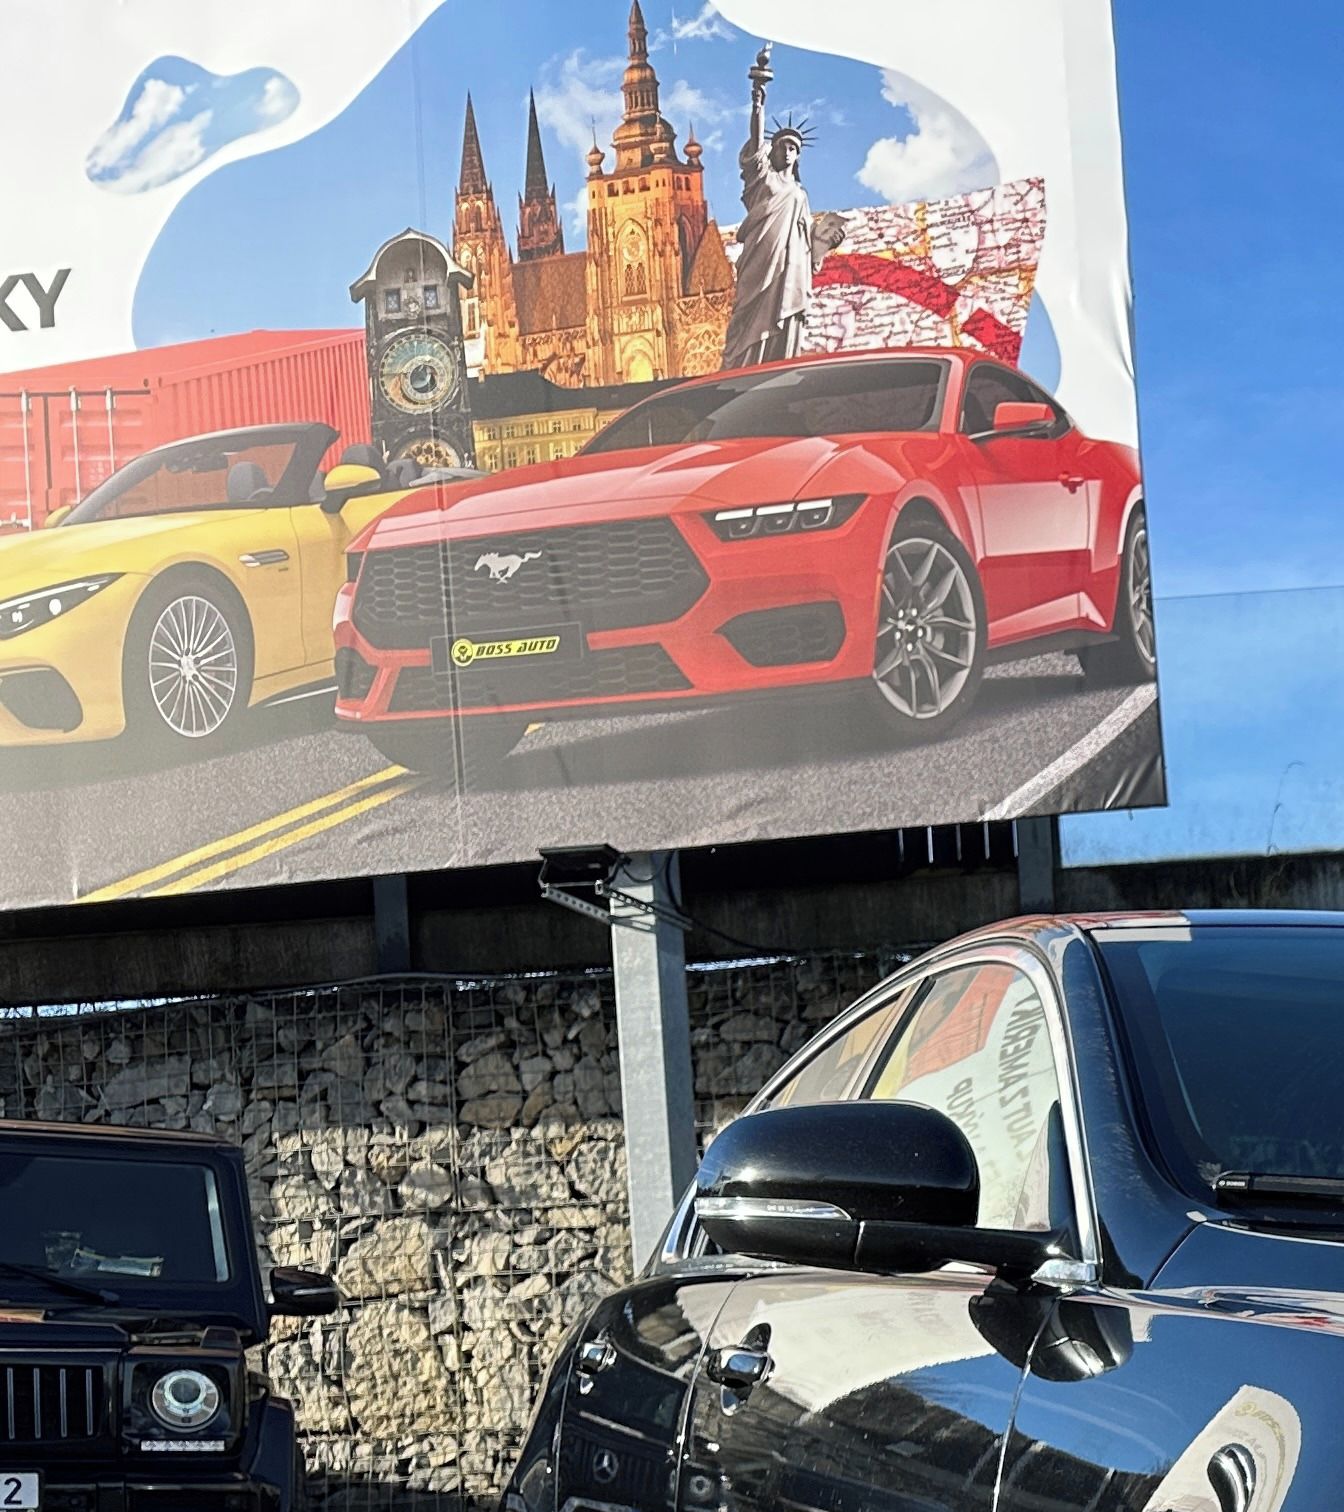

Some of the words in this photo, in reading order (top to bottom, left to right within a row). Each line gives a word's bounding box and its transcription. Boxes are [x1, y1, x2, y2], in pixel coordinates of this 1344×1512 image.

[475, 643, 512, 657] BOSS
[517, 639, 557, 653] AUTO
[4, 1477, 22, 1505] 2
